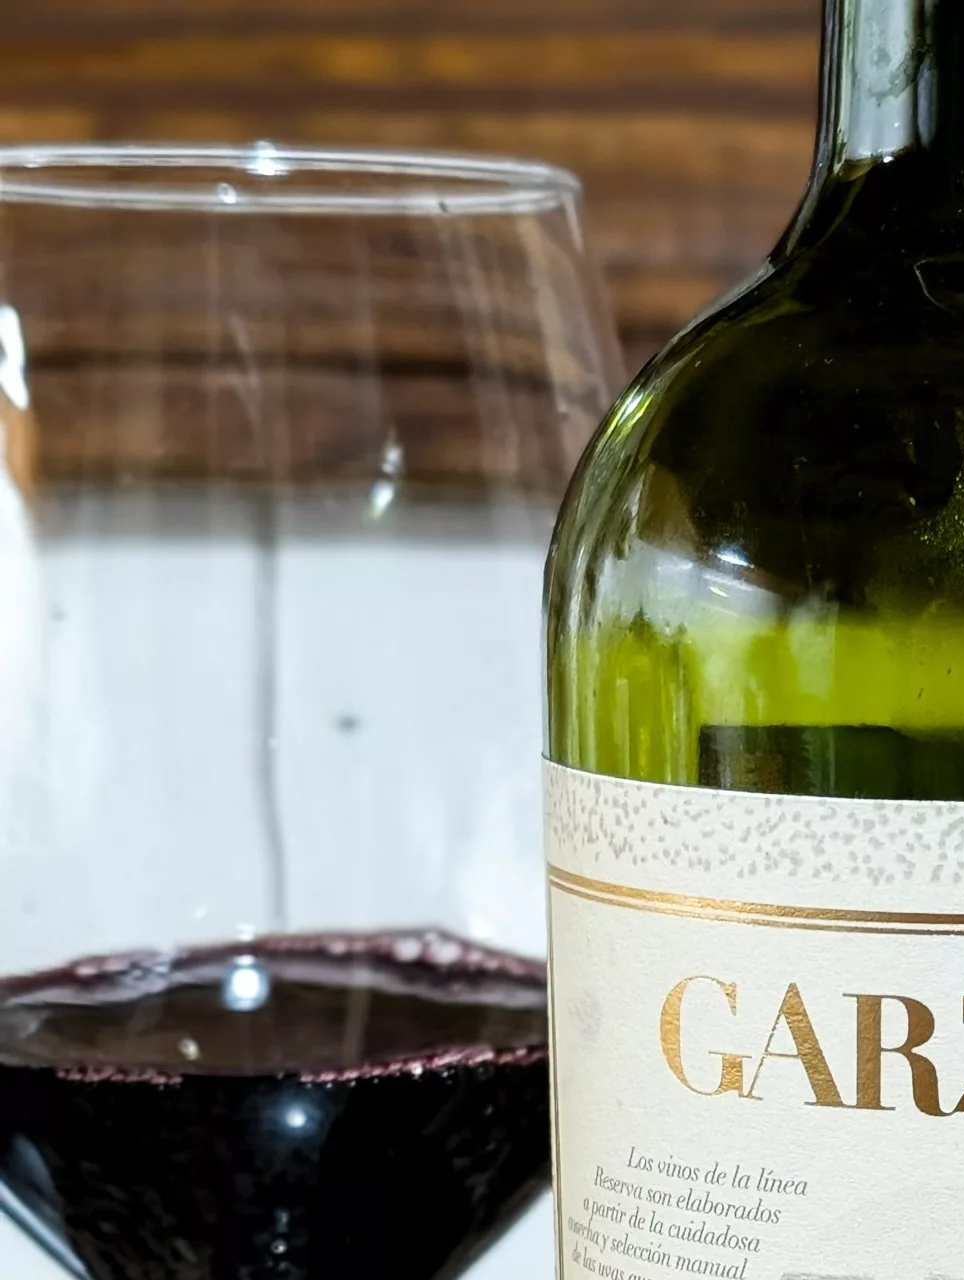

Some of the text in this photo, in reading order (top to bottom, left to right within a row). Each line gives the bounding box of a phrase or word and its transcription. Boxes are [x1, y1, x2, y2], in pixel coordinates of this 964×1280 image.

[594, 1165, 781, 1224] Reserva son elaborados
[627, 1146, 807, 1196] Los vinos de la línea
[583, 1197, 760, 1253] a partir de la cuidadosa
[572, 1240, 581, 1264] de
[583, 1248, 596, 1273] las
[599, 1235, 610, 1253] y
[612, 1233, 670, 1268] selección
[675, 1255, 748, 1280] manual
